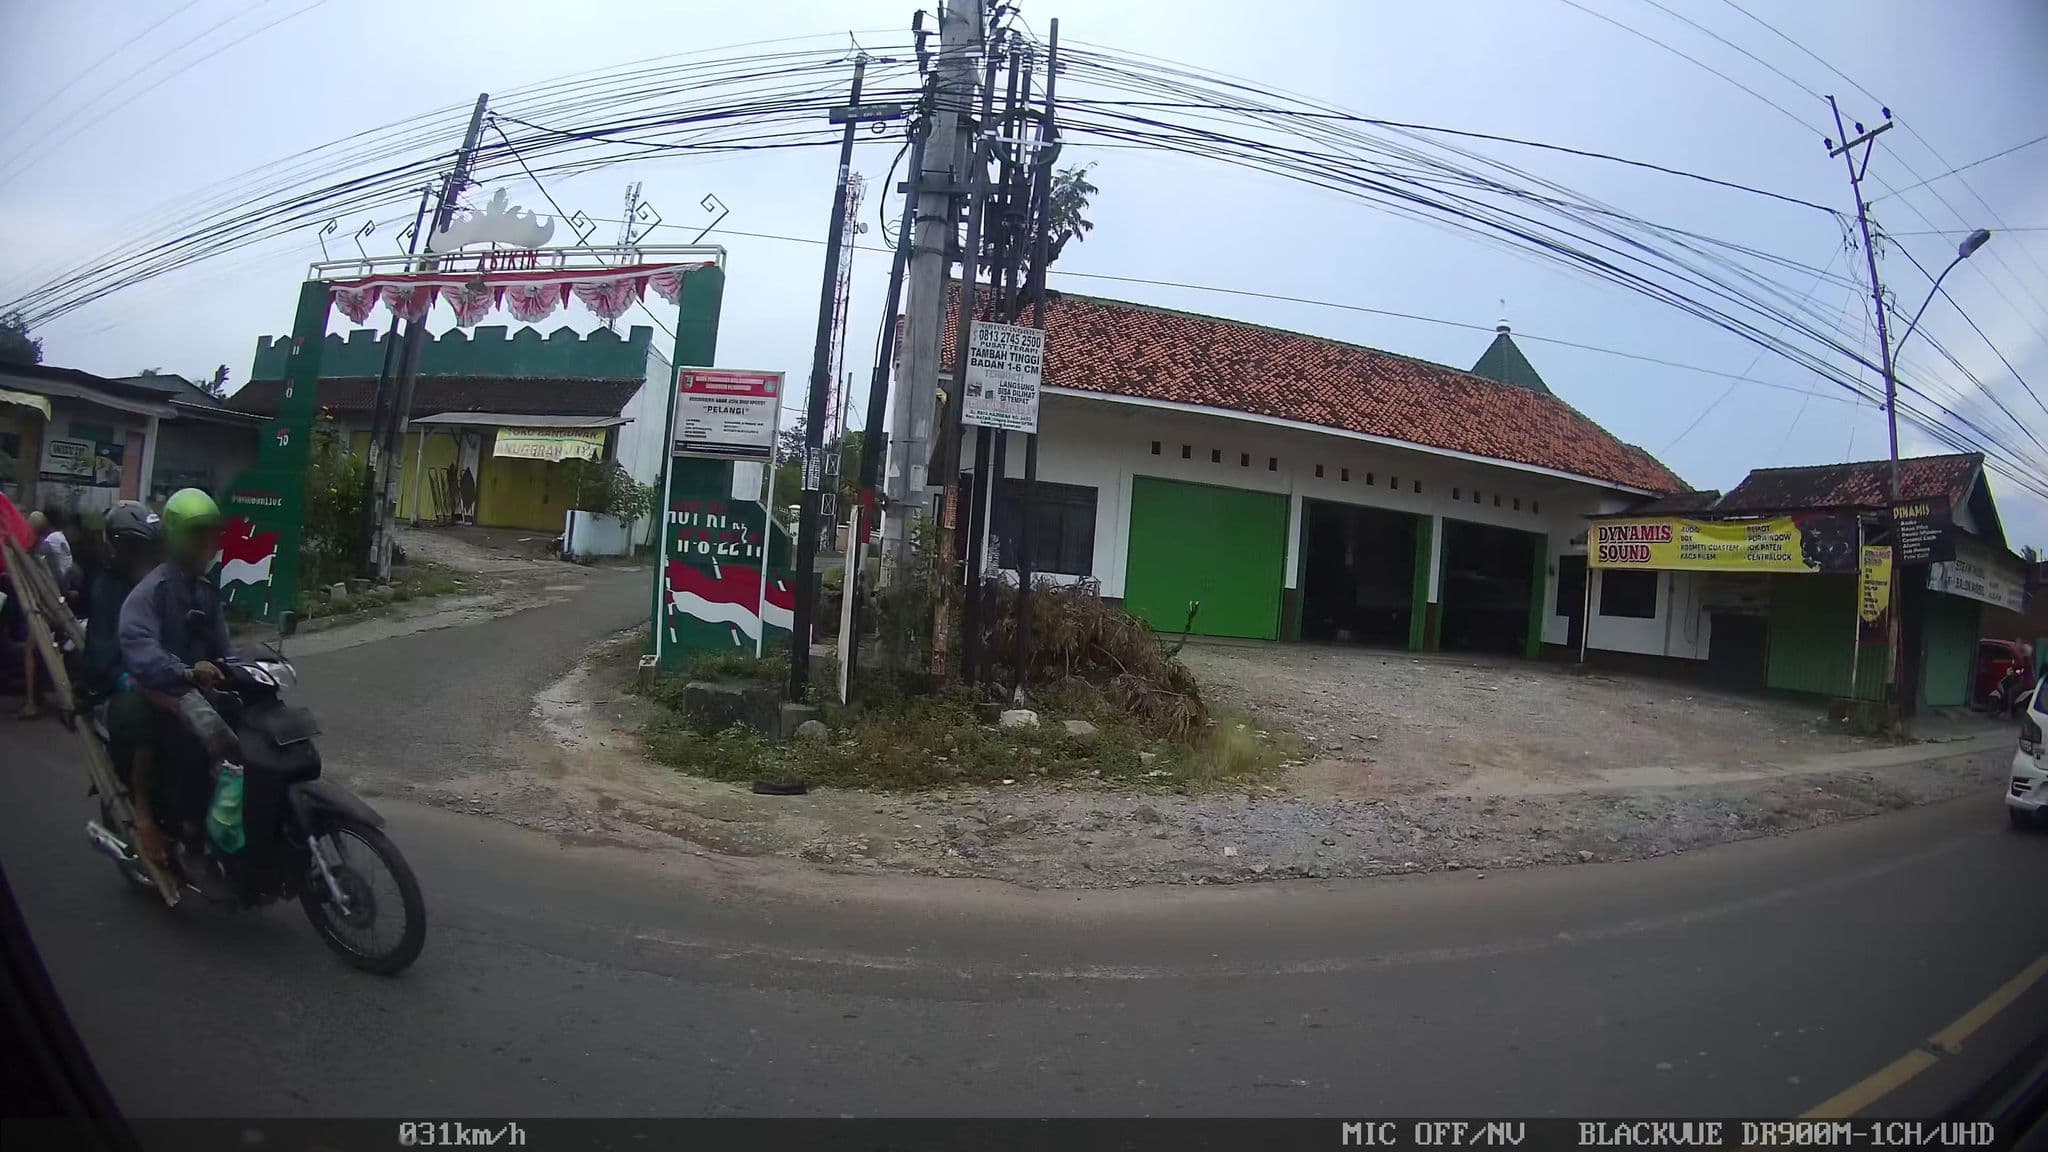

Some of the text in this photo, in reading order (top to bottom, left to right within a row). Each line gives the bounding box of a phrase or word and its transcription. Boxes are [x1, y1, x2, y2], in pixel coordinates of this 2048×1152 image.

[979, 329, 1041, 348] 0813 2745 2500
[970, 347, 1040, 365] TAMBAH TINGGI
[970, 358, 1039, 375] BADAN 1-6 CM
[999, 380, 1035, 391] LANGSUNG
[1598, 524, 1673, 542] DYNAMIS
[1599, 544, 1652, 562] SOUND
